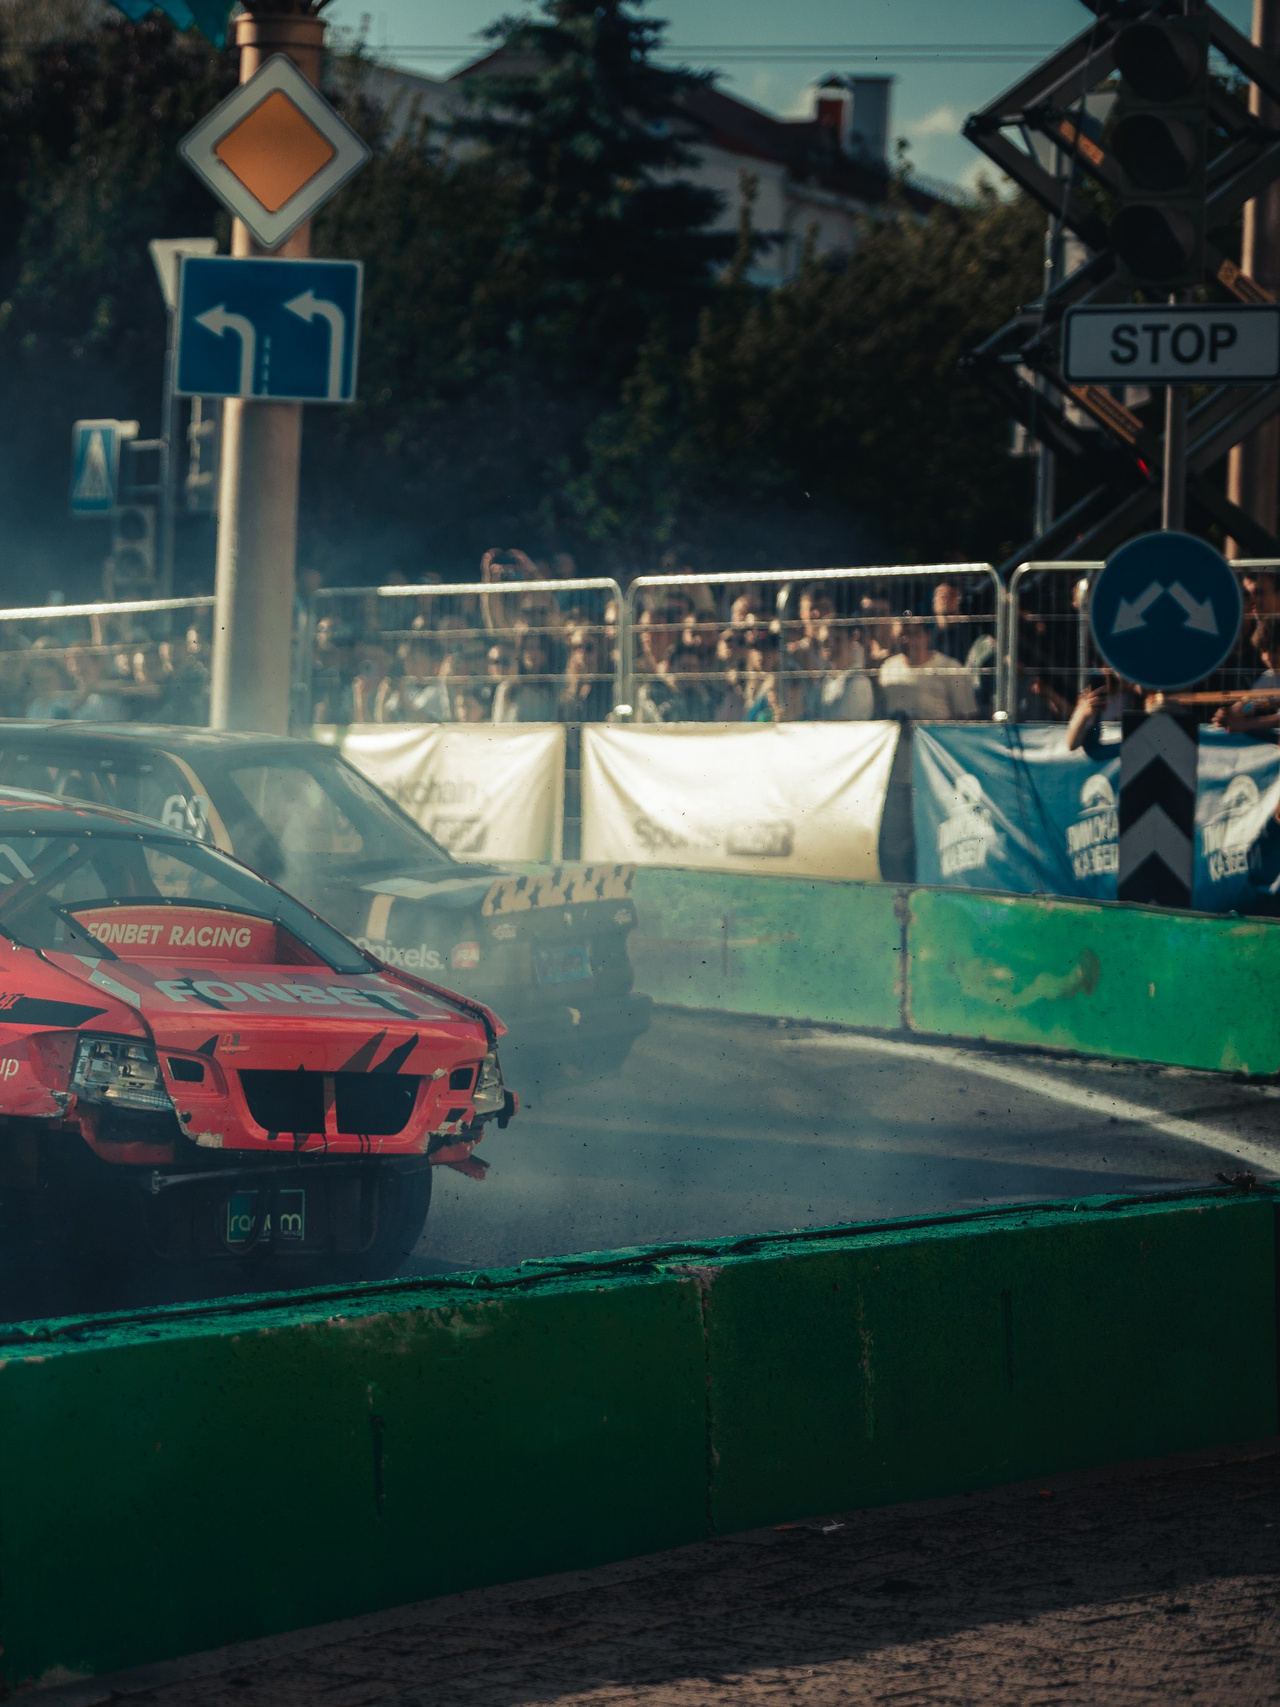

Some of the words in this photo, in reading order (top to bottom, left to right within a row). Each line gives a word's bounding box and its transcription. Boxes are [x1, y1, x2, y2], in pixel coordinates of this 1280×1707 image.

[1110, 322, 1238, 365] STOP
[87, 923, 164, 945] FONBET
[168, 926, 252, 948] RACING
[154, 980, 405, 1011] FONBET
